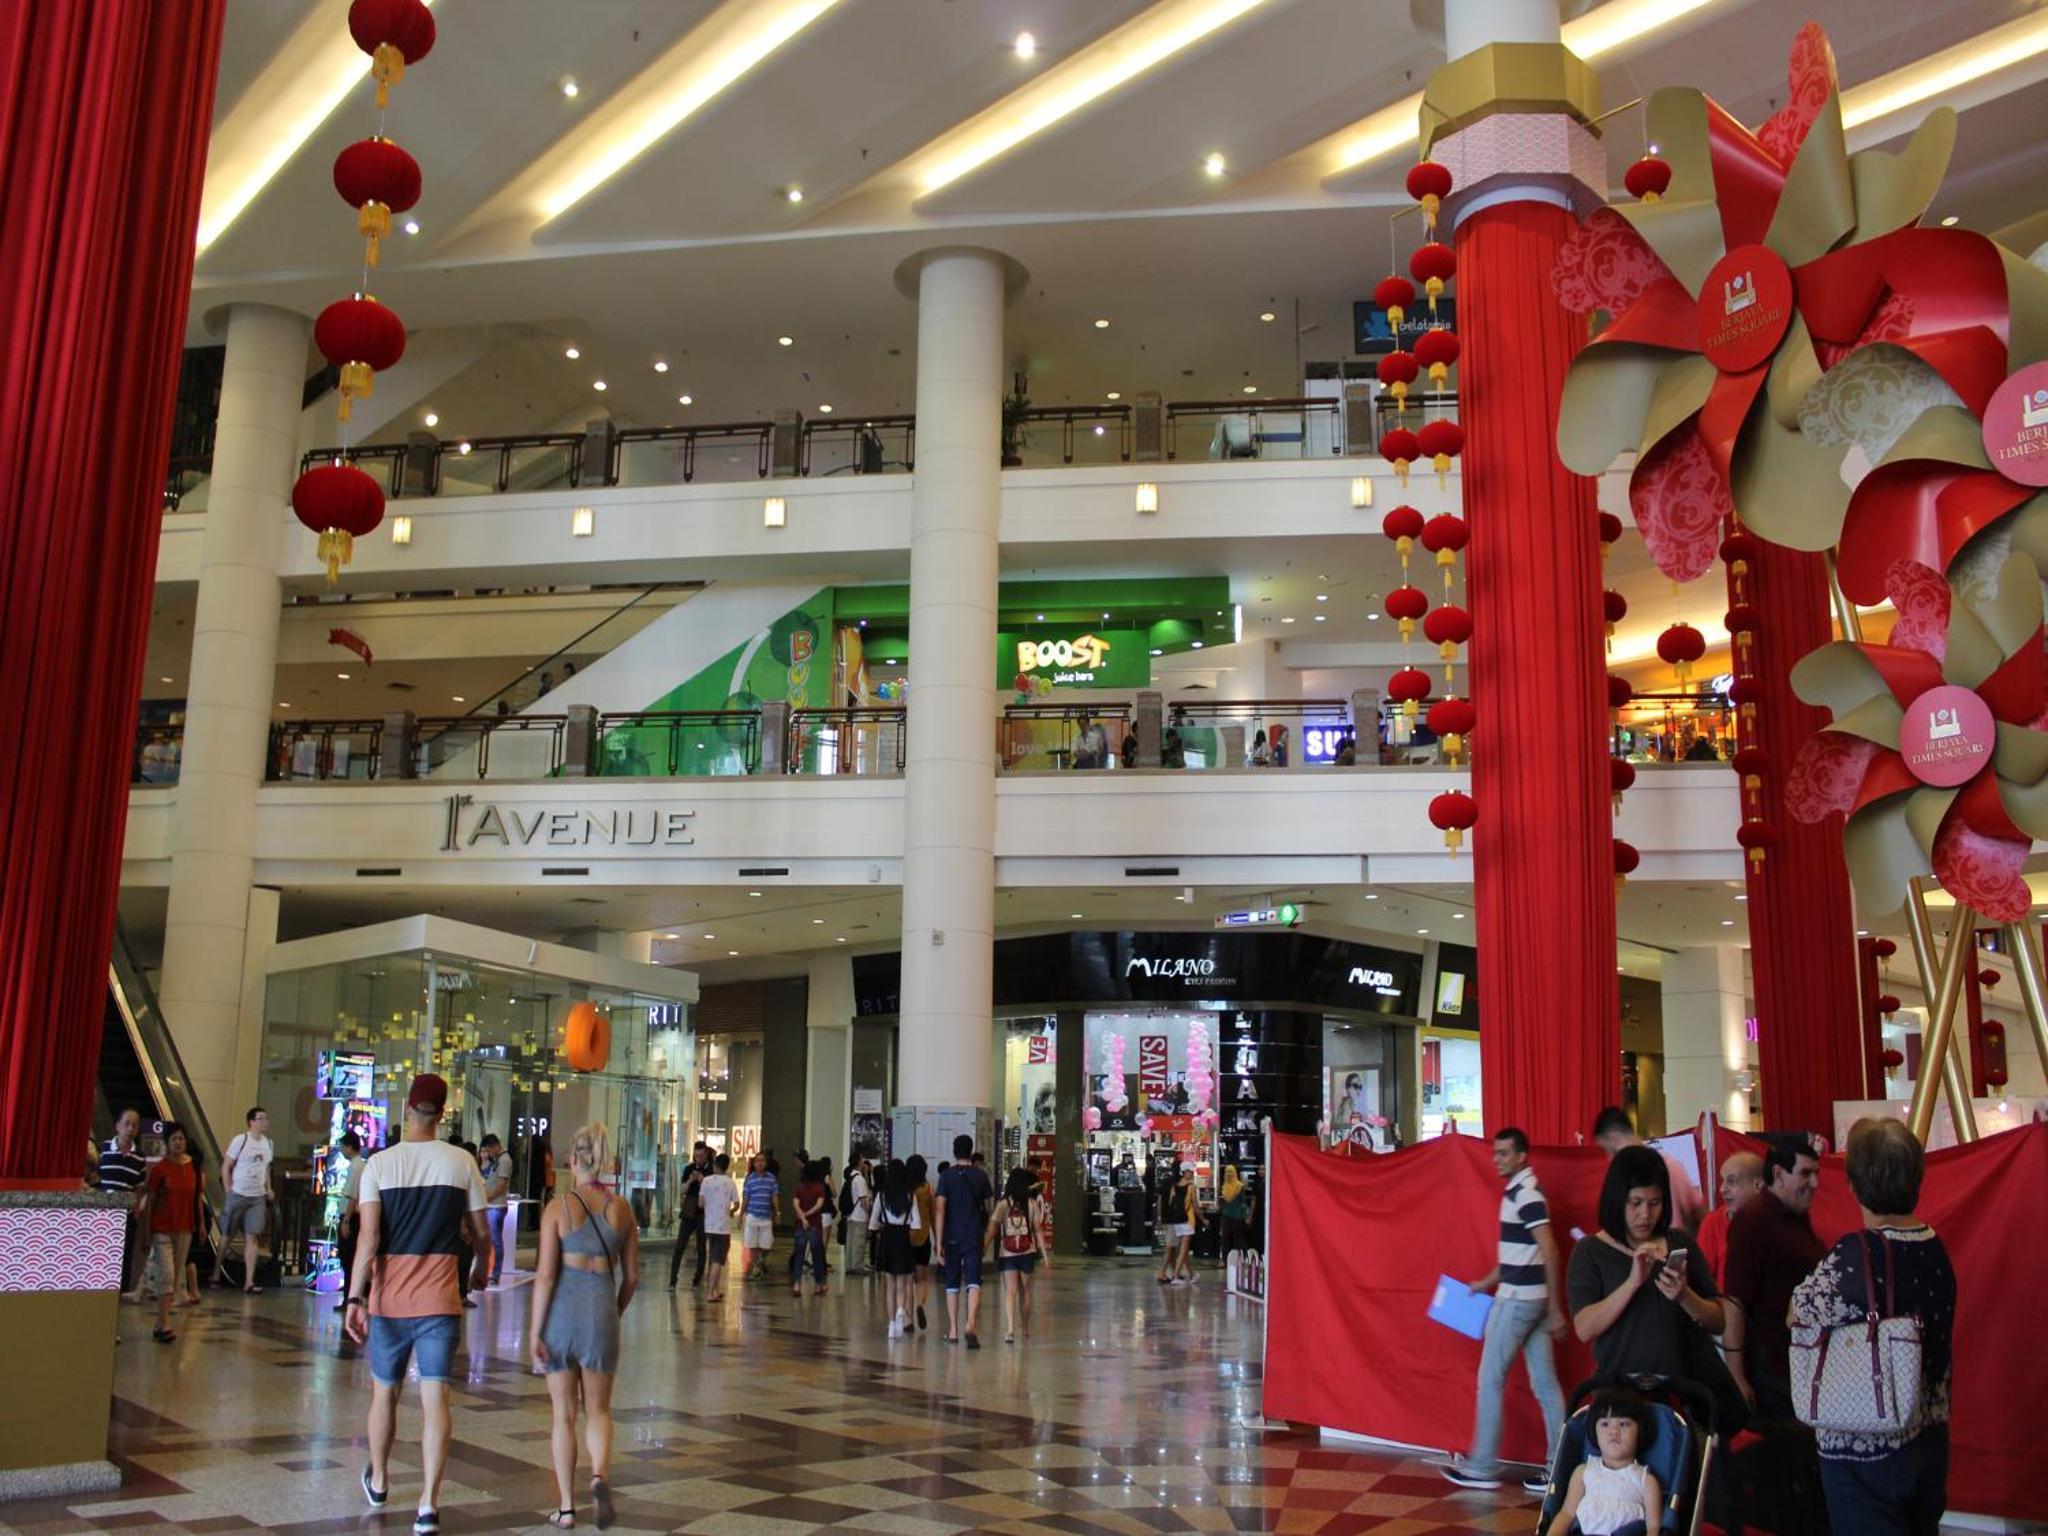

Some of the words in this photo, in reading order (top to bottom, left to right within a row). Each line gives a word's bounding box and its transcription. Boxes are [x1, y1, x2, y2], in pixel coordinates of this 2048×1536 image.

[1999, 440, 2039, 460] TIMES
[467, 803, 696, 846] AVENUE
[1125, 957, 1215, 978] MILANO
[1141, 1037, 1166, 1091] SAVE
[152, 1121, 164, 1134] G
